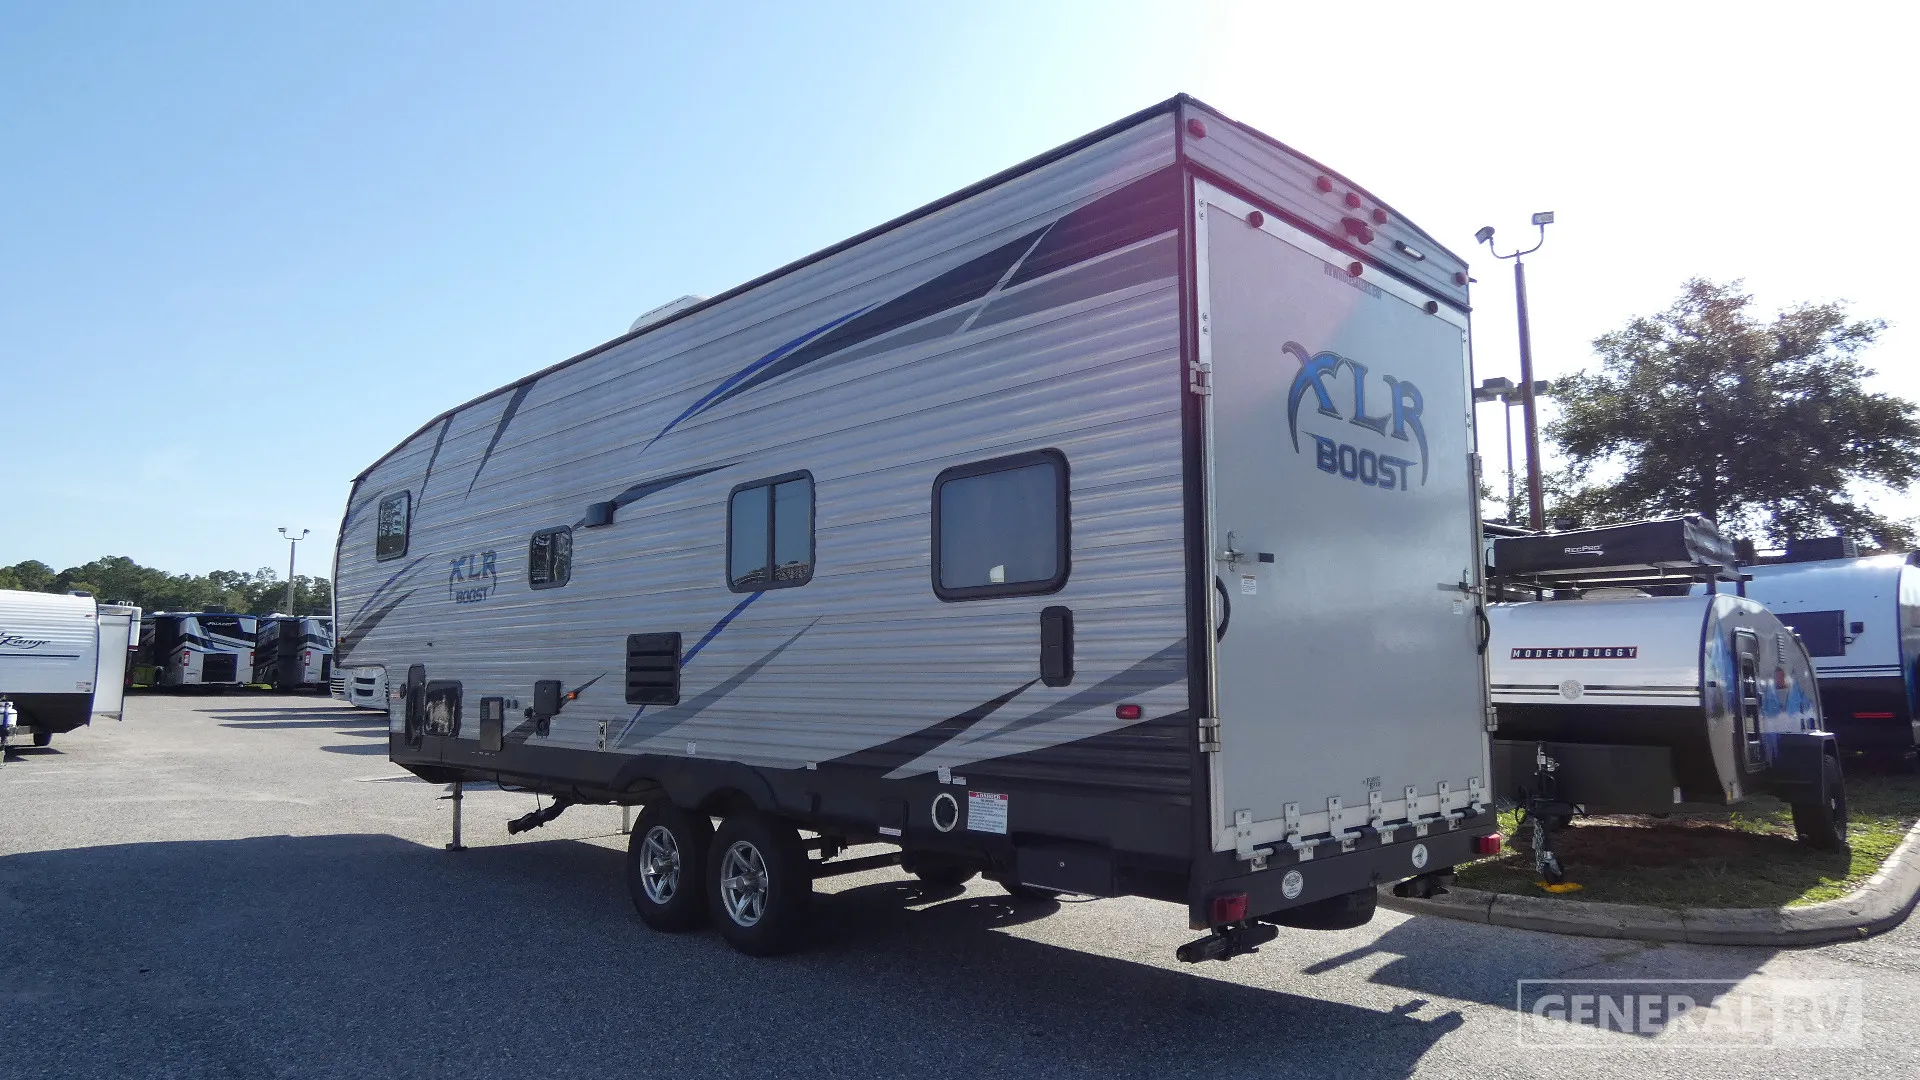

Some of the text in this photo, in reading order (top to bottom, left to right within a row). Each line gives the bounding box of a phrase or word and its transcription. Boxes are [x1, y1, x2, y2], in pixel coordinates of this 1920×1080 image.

[1281, 341, 1429, 486] XLR
[1301, 430, 1418, 491] BOOST
[449, 550, 497, 600] XLR
[455, 587, 489, 604] BOOST
